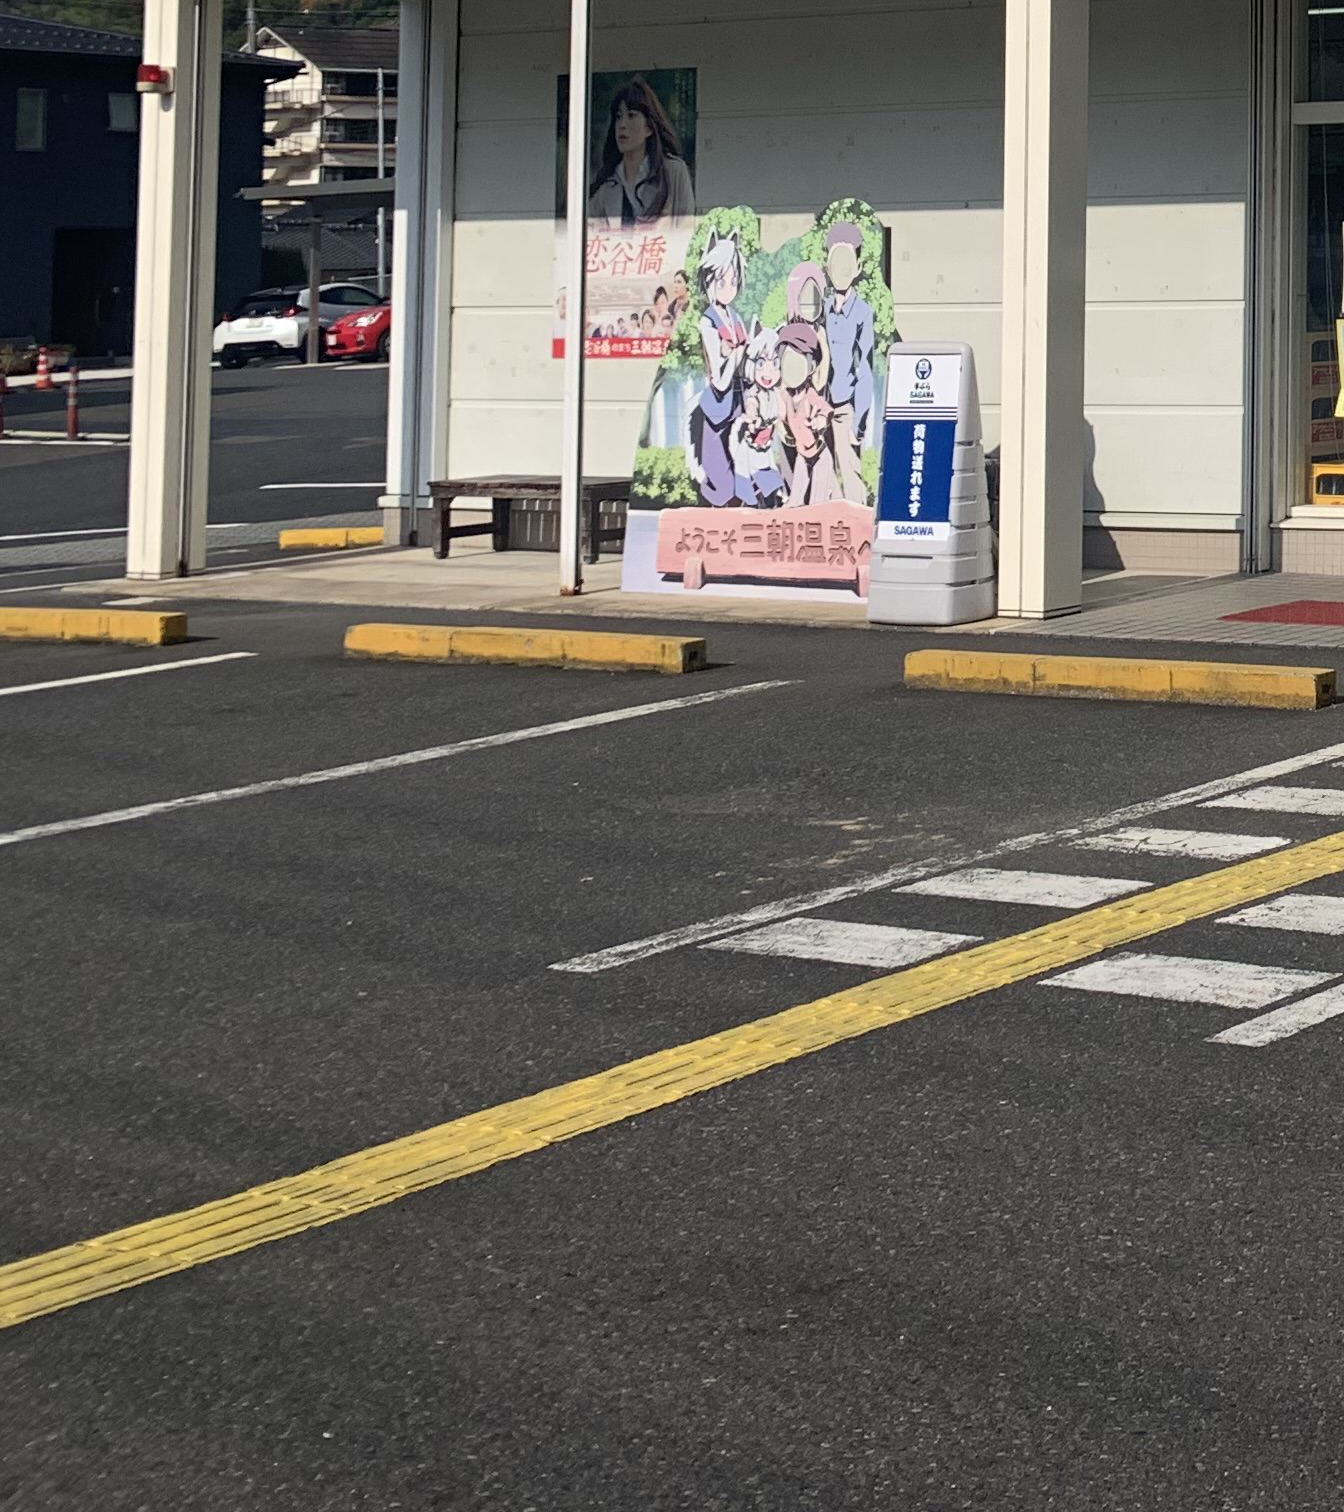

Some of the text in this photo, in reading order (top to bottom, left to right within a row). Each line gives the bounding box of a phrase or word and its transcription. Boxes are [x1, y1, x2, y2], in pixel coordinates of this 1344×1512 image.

[909, 391, 935, 399] SAGAWA
[908, 423, 927, 518] 荷物送れます
[893, 525, 934, 537] SAGAWA
